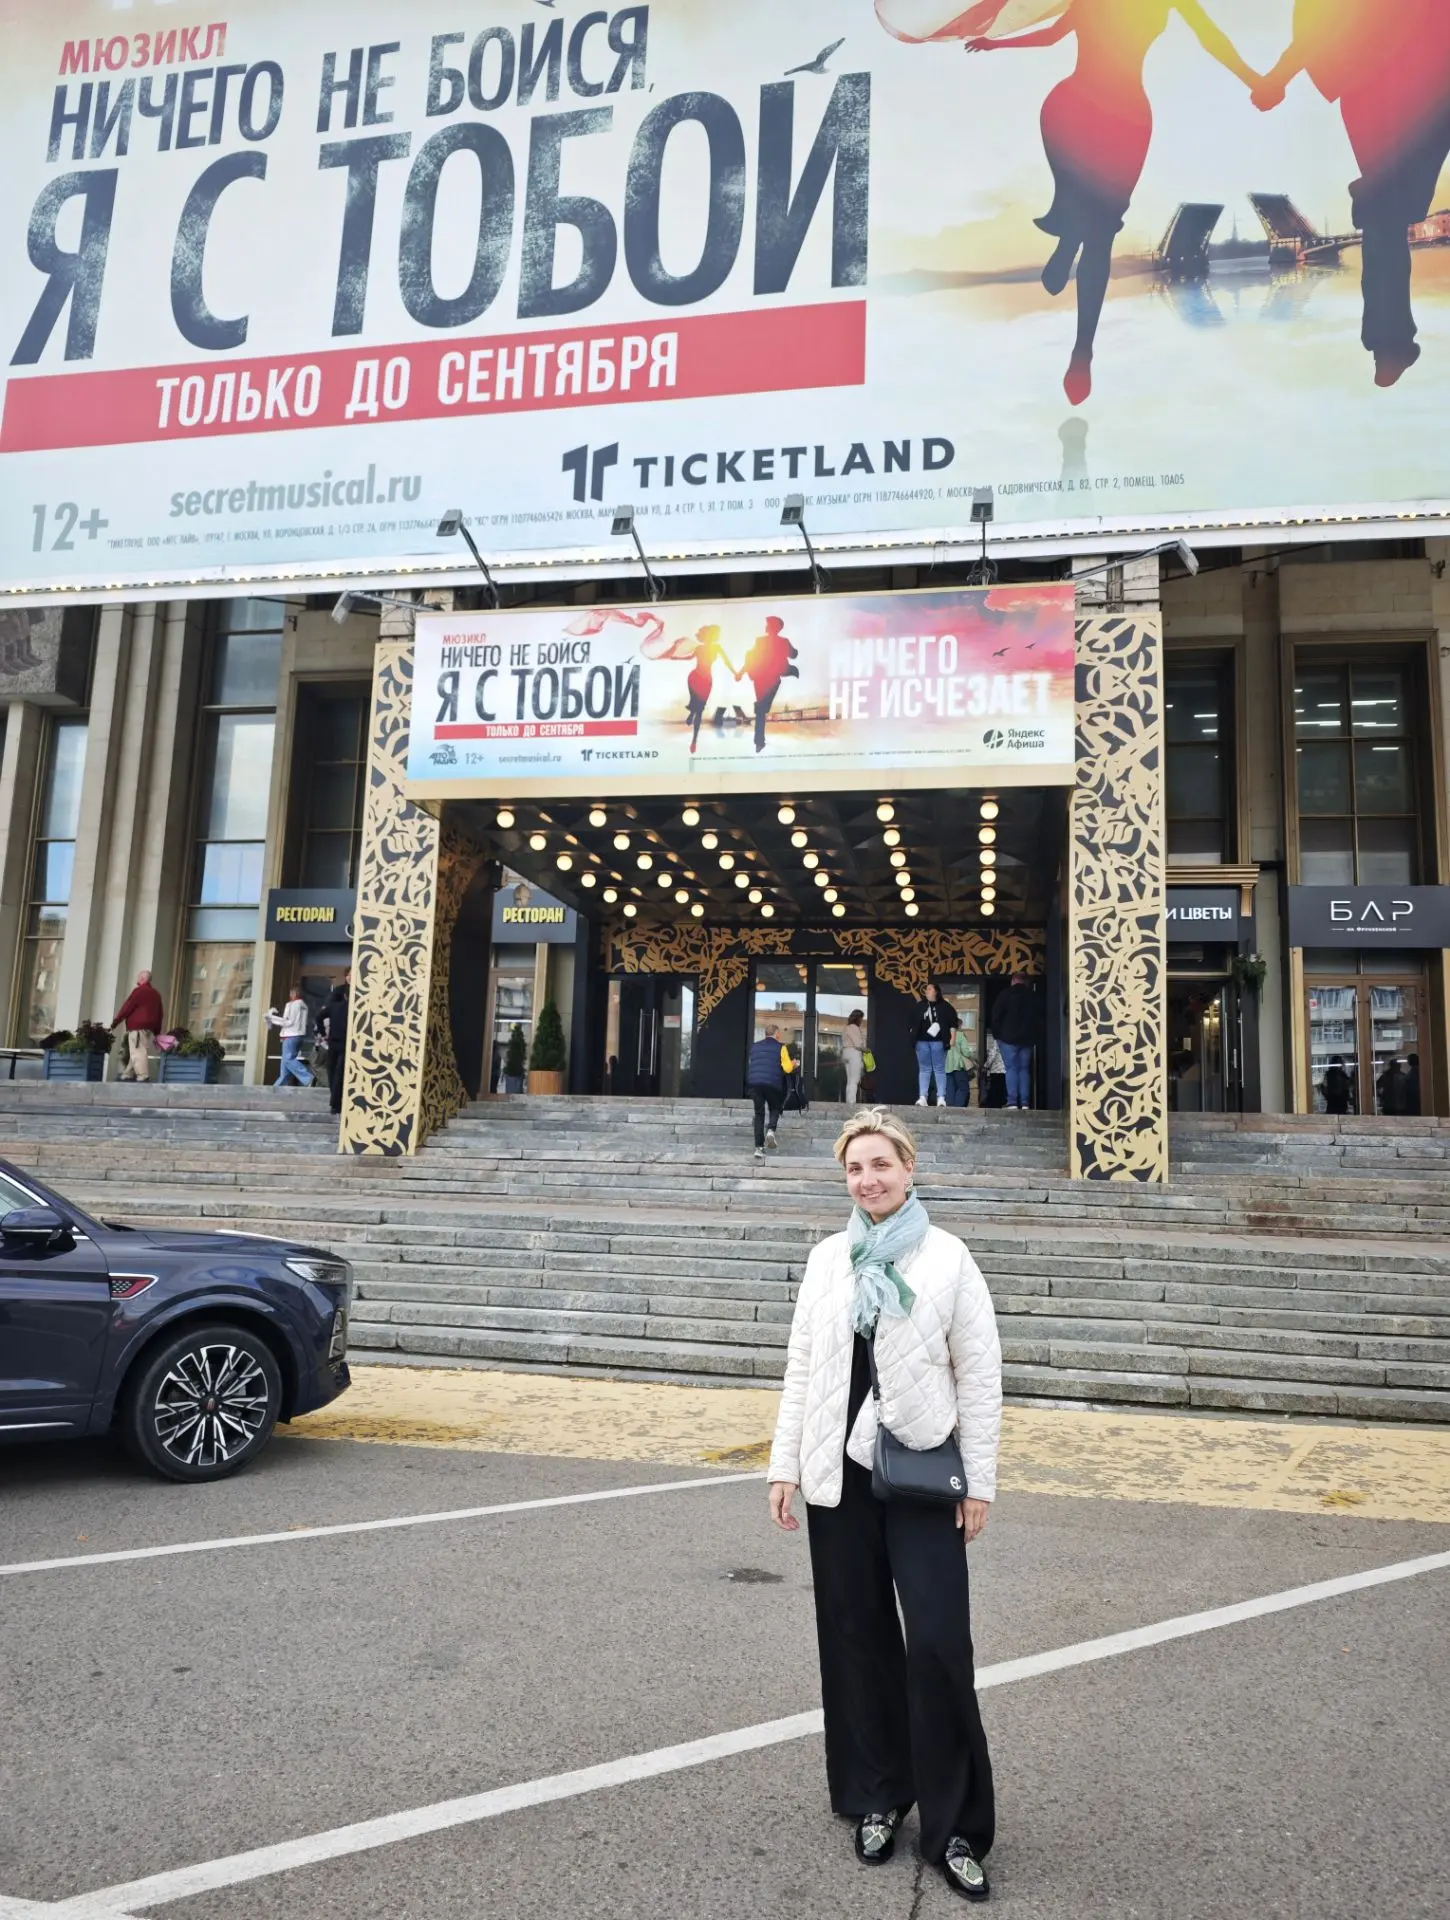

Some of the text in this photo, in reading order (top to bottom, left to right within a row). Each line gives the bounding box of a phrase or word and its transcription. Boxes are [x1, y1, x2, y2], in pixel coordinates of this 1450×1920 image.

[59, 22, 227, 75] МЮЗИКЛ
[46, 60, 284, 162] НИЧЕГО
[316, 41, 400, 133] НЕ
[9, 38, 871, 366] Я С ТОБОЙ
[155, 332, 678, 428] ТОЛЬКО ДО СЕНТЯБРЯ
[633, 436, 955, 488] TICKETLAND
[169, 463, 422, 518] secretmusical.ru
[720, 499, 724, 511] 2
[749, 498, 754, 510] 3
[764, 497, 780, 508] ООО
[853, 492, 872, 503] ОГРН
[998, 480, 1064, 495] САДОВНИЧЕСКАЯ,
[31, 501, 109, 552] 12+
[443, 633, 487, 644] МЮЗИКЛ
[441, 645, 501, 668] НИЧЕГО
[510, 644, 530, 666] НЕ
[831, 635, 958, 677] НИЧЕГО
[435, 656, 640, 723] Я С ТОБОЙ
[829, 672, 1052, 719] НЕ ИСЧЕЗАЕТ
[486, 723, 584, 737] ТОЛЬКО ДО СЕНТЯБРЯ
[1008, 729, 1045, 739] Яндекс
[596, 751, 659, 761] TICKETLAND
[1008, 739, 1045, 749] Афиша
[465, 752, 485, 764] 12+
[276, 907, 335, 923] РЕСТОРАН
[503, 907, 565, 923] РЕСТОРАН
[1165, 907, 1232, 920] И ЦВЕТЫ
[1331, 900, 1413, 920] БАР
